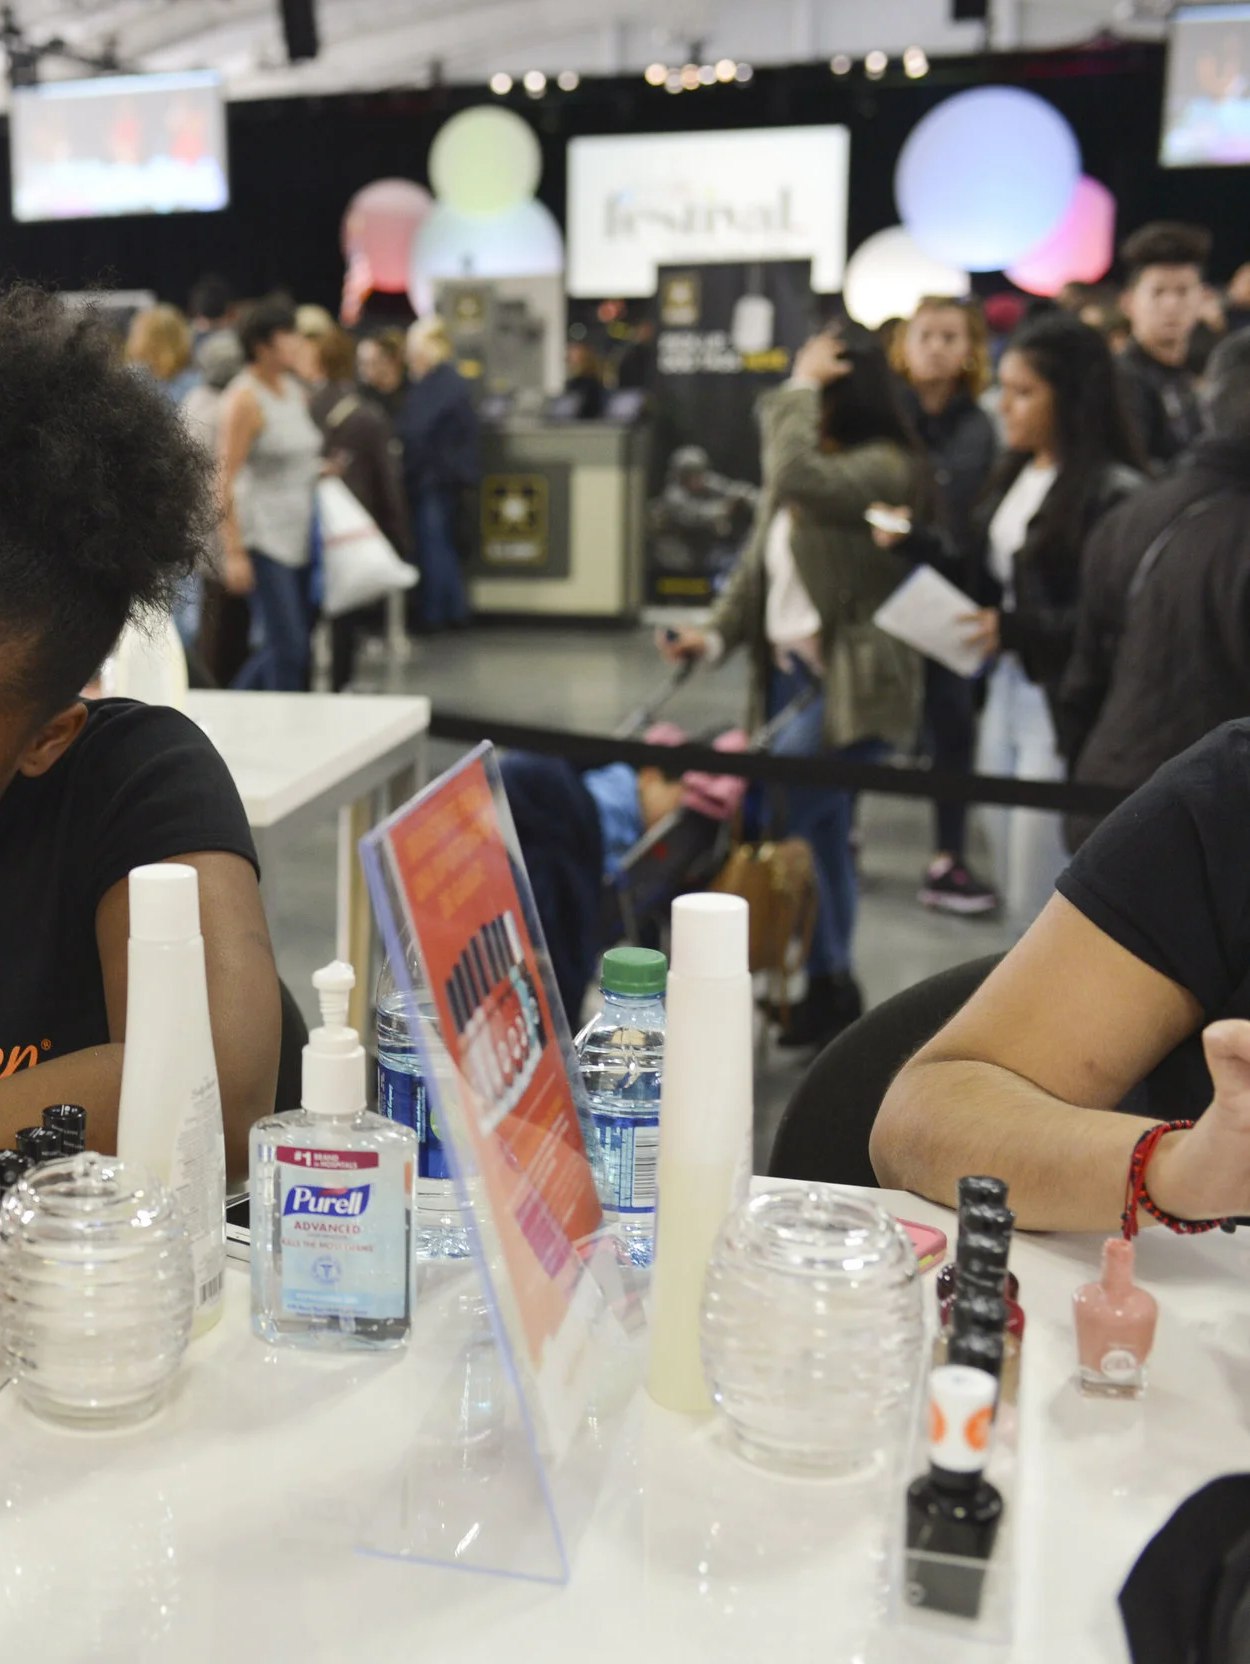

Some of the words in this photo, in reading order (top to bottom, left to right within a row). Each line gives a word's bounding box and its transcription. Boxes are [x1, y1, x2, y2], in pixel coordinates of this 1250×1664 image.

[293, 1150, 312, 1167] #1
[292, 1187, 364, 1215] Purell
[293, 1221, 361, 1234] ADVANCED
